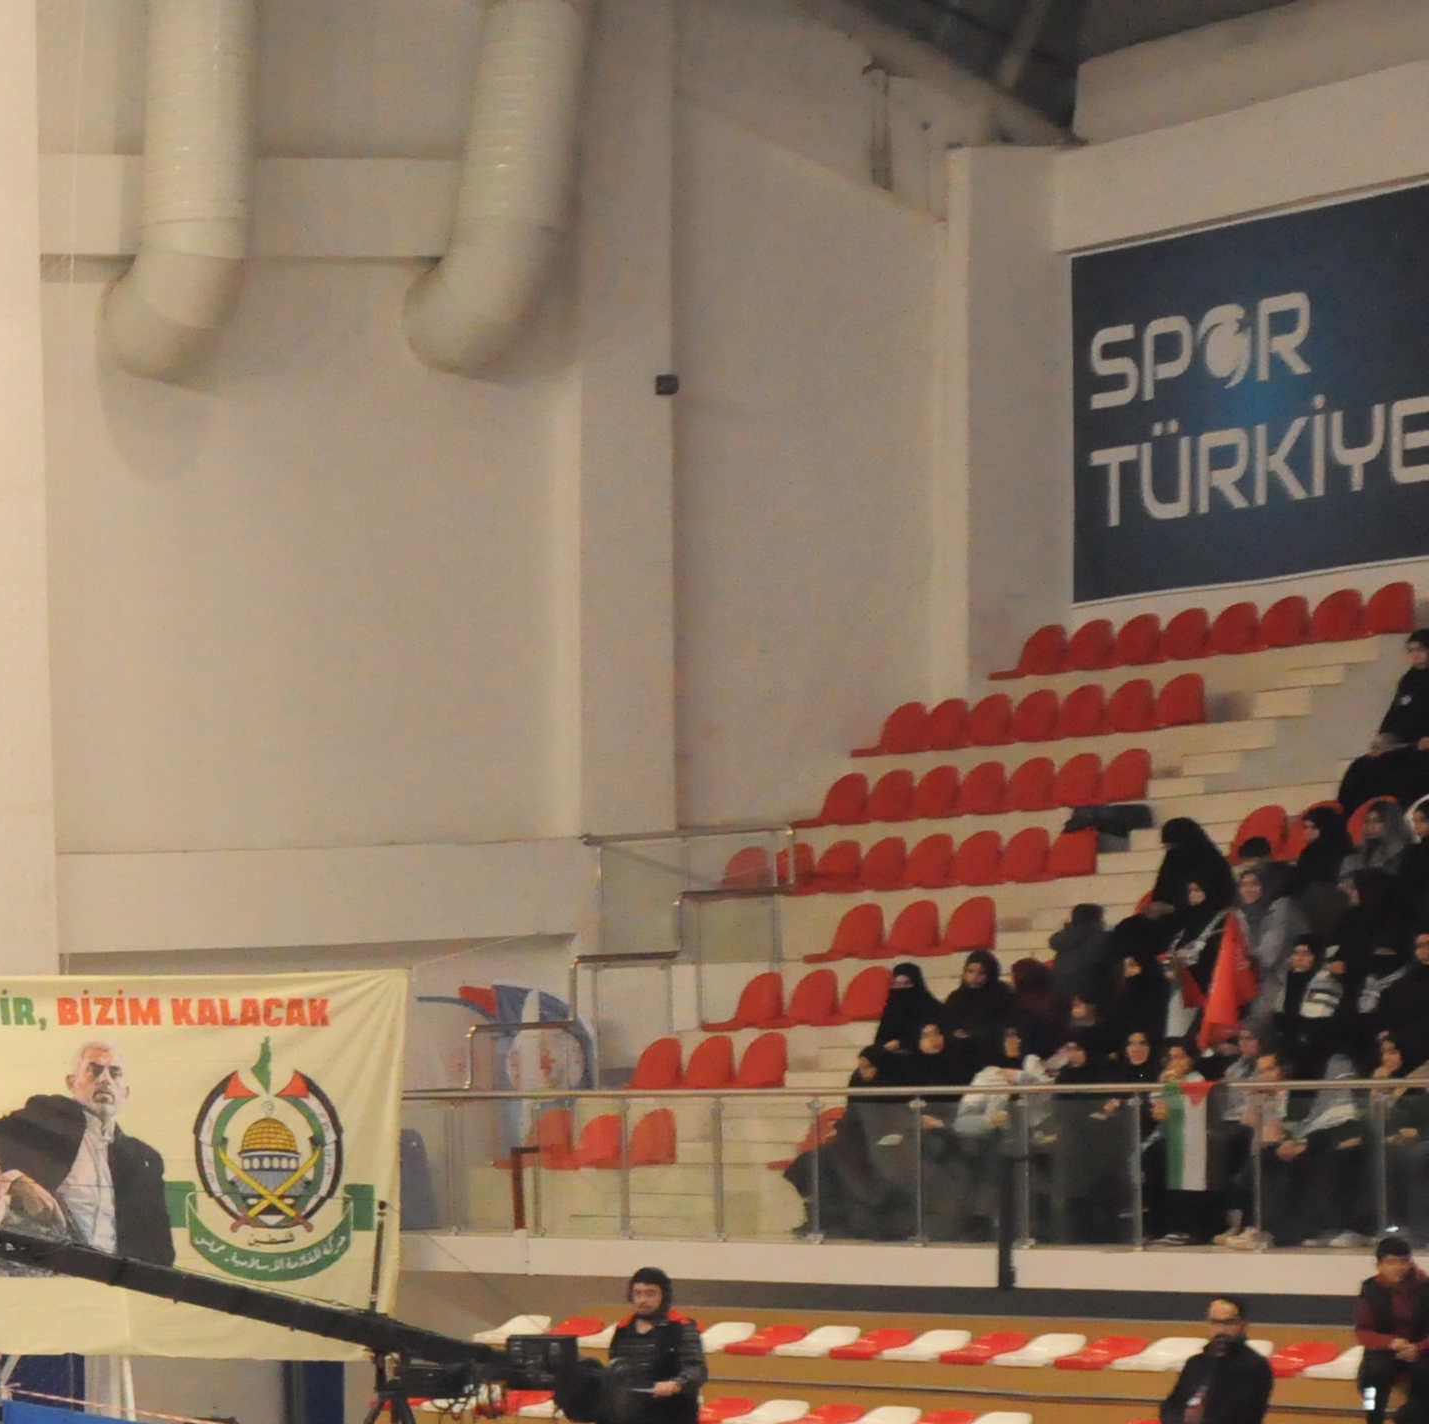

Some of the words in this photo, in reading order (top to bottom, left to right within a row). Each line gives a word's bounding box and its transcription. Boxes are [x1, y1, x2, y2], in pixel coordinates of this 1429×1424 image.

[1090, 292, 1311, 409] SPOR
[1089, 394, 1429, 527] TÜRKİYE
[56, 988, 162, 1027] BİZİM
[170, 997, 331, 1027] KALACAK
